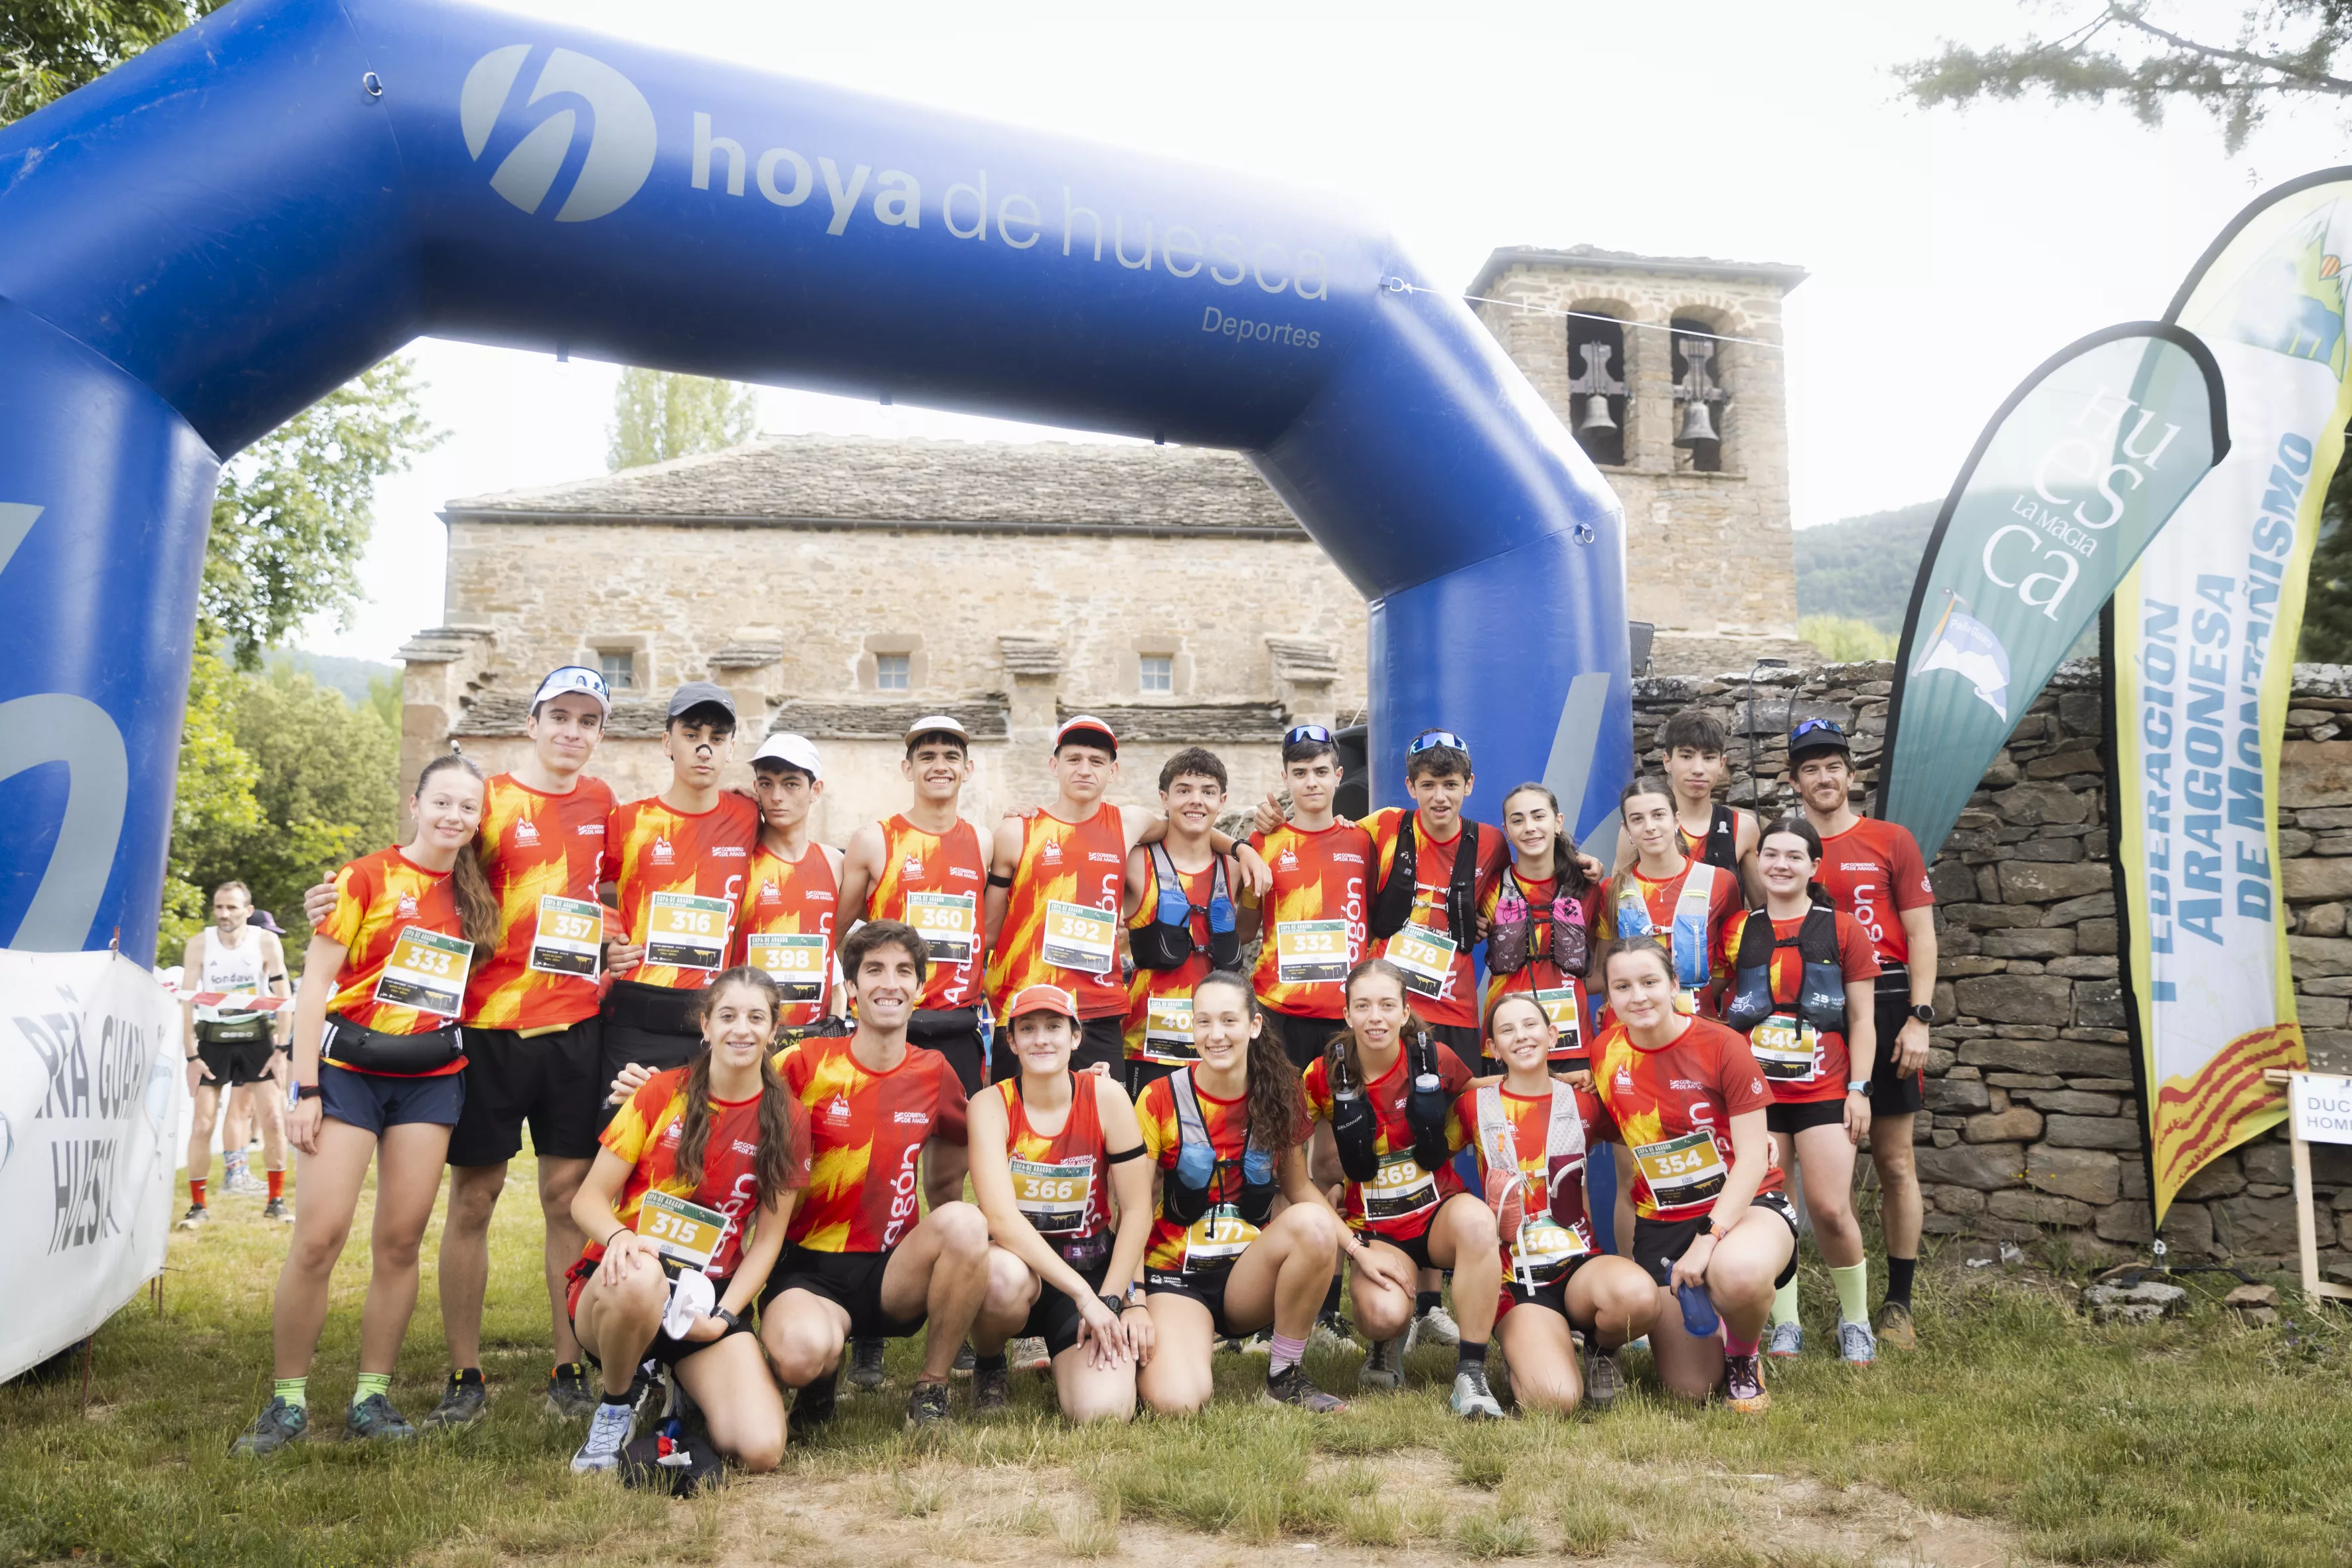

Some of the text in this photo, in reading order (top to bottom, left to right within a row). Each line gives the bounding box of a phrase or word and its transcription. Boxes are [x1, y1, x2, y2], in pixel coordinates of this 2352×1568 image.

[690, 112, 1328, 301] hoya de huesca
[1202, 306, 1321, 349] Deportes
[2177, 574, 2236, 947] ARAGONESA
[2236, 840, 2272, 923] DE
[545, 898, 556, 907] COPA
[554, 915, 593, 939] 357
[670, 911, 711, 933] 316
[921, 908, 963, 928] 360
[1060, 917, 1099, 941] 392
[1294, 935, 1333, 952] 332
[1399, 939, 1438, 964] 378
[404, 946, 452, 974] 333
[765, 949, 809, 969] 398
[1812, 992, 1829, 1003] 25
[1162, 1012, 1193, 1028] 40
[1760, 1029, 1802, 1049] 340
[1337, 1114, 1364, 1131] SALOMON
[2307, 1116, 2352, 1131] HOM
[1654, 1149, 1702, 1175] 354
[1375, 1162, 1417, 1186] 369
[1024, 1179, 1073, 1199] 366
[650, 1212, 700, 1243] 315
[1525, 1230, 1569, 1251] 346
